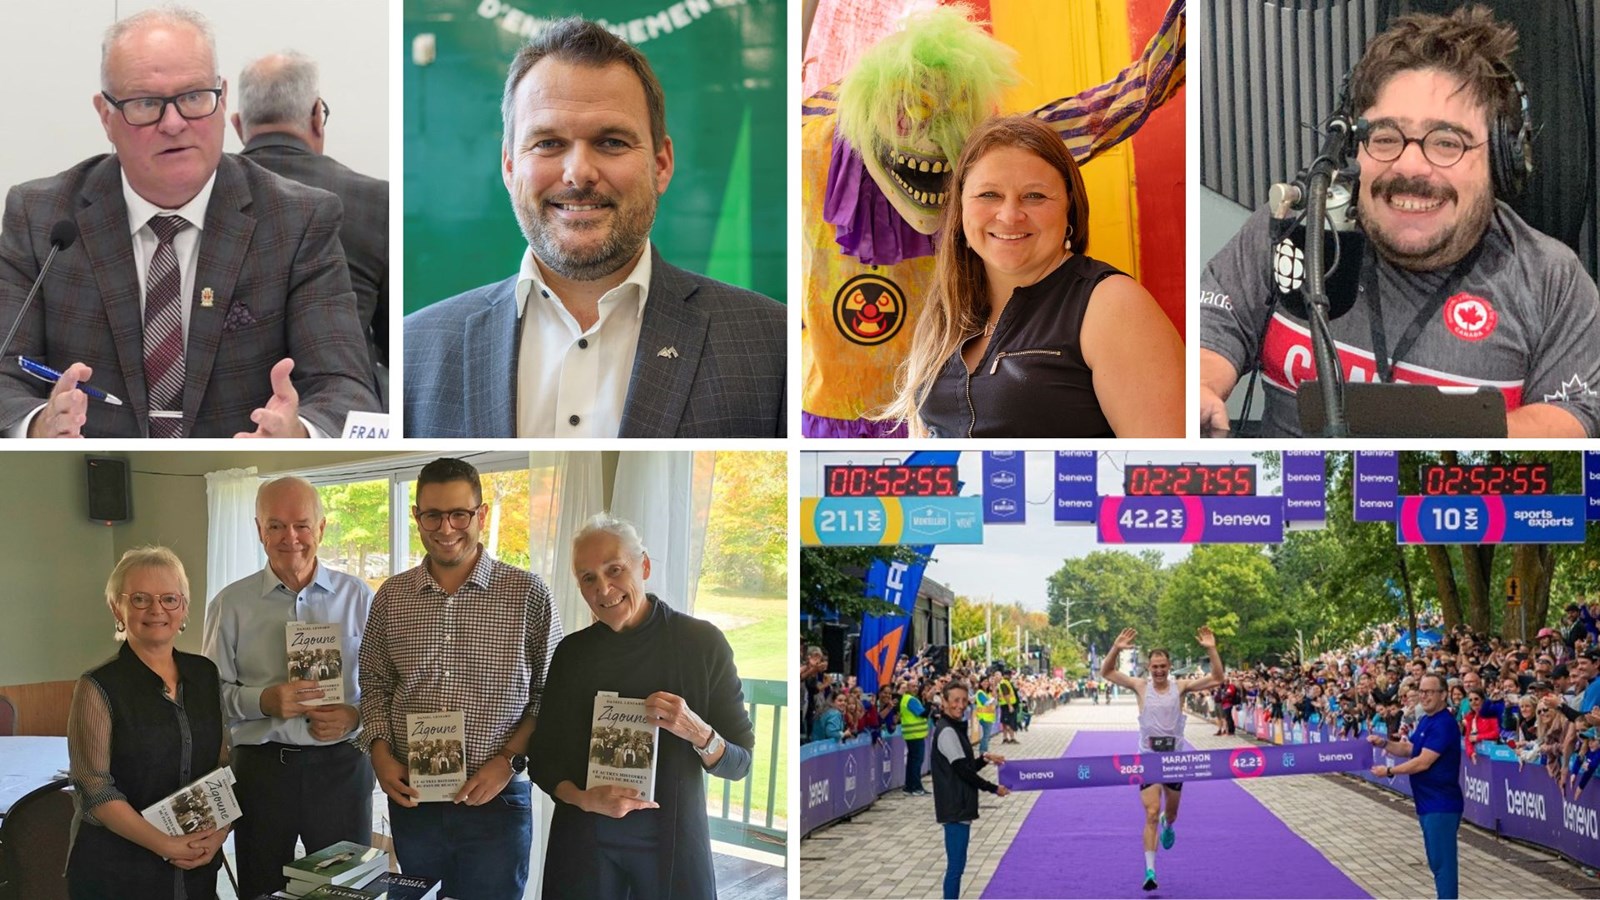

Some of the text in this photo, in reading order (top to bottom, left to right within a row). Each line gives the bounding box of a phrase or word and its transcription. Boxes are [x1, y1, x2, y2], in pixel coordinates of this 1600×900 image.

[1059, 472, 1093, 482] beneva
[1130, 467, 1250, 496] 02:27:55
[1287, 473, 1321, 482] beneva
[1360, 473, 1394, 482] beneva
[1427, 468, 1547, 496] 02:52:55
[1058, 498, 1093, 508] beneva
[1288, 498, 1321, 507] beneva
[1360, 498, 1394, 508] beneva
[820, 510, 882, 532] 21.1 KM
[1119, 508, 1184, 529] 42.2 KM
[1212, 511, 1271, 526] beneva
[1432, 508, 1478, 530] 10 KM
[1514, 510, 1553, 521] sports
[1528, 516, 1575, 528] experts
[291, 632, 336, 652] Zigoune
[411, 720, 457, 742] Zigoune
[1161, 754, 1211, 764] MARATHON
[1319, 753, 1354, 762] beneva
[1020, 771, 1054, 780] beneva
[1120, 765, 1144, 774] 2023
[1464, 766, 1490, 806] beneva
[203, 779, 230, 820] Zigoune
[1505, 778, 1546, 820] beneva
